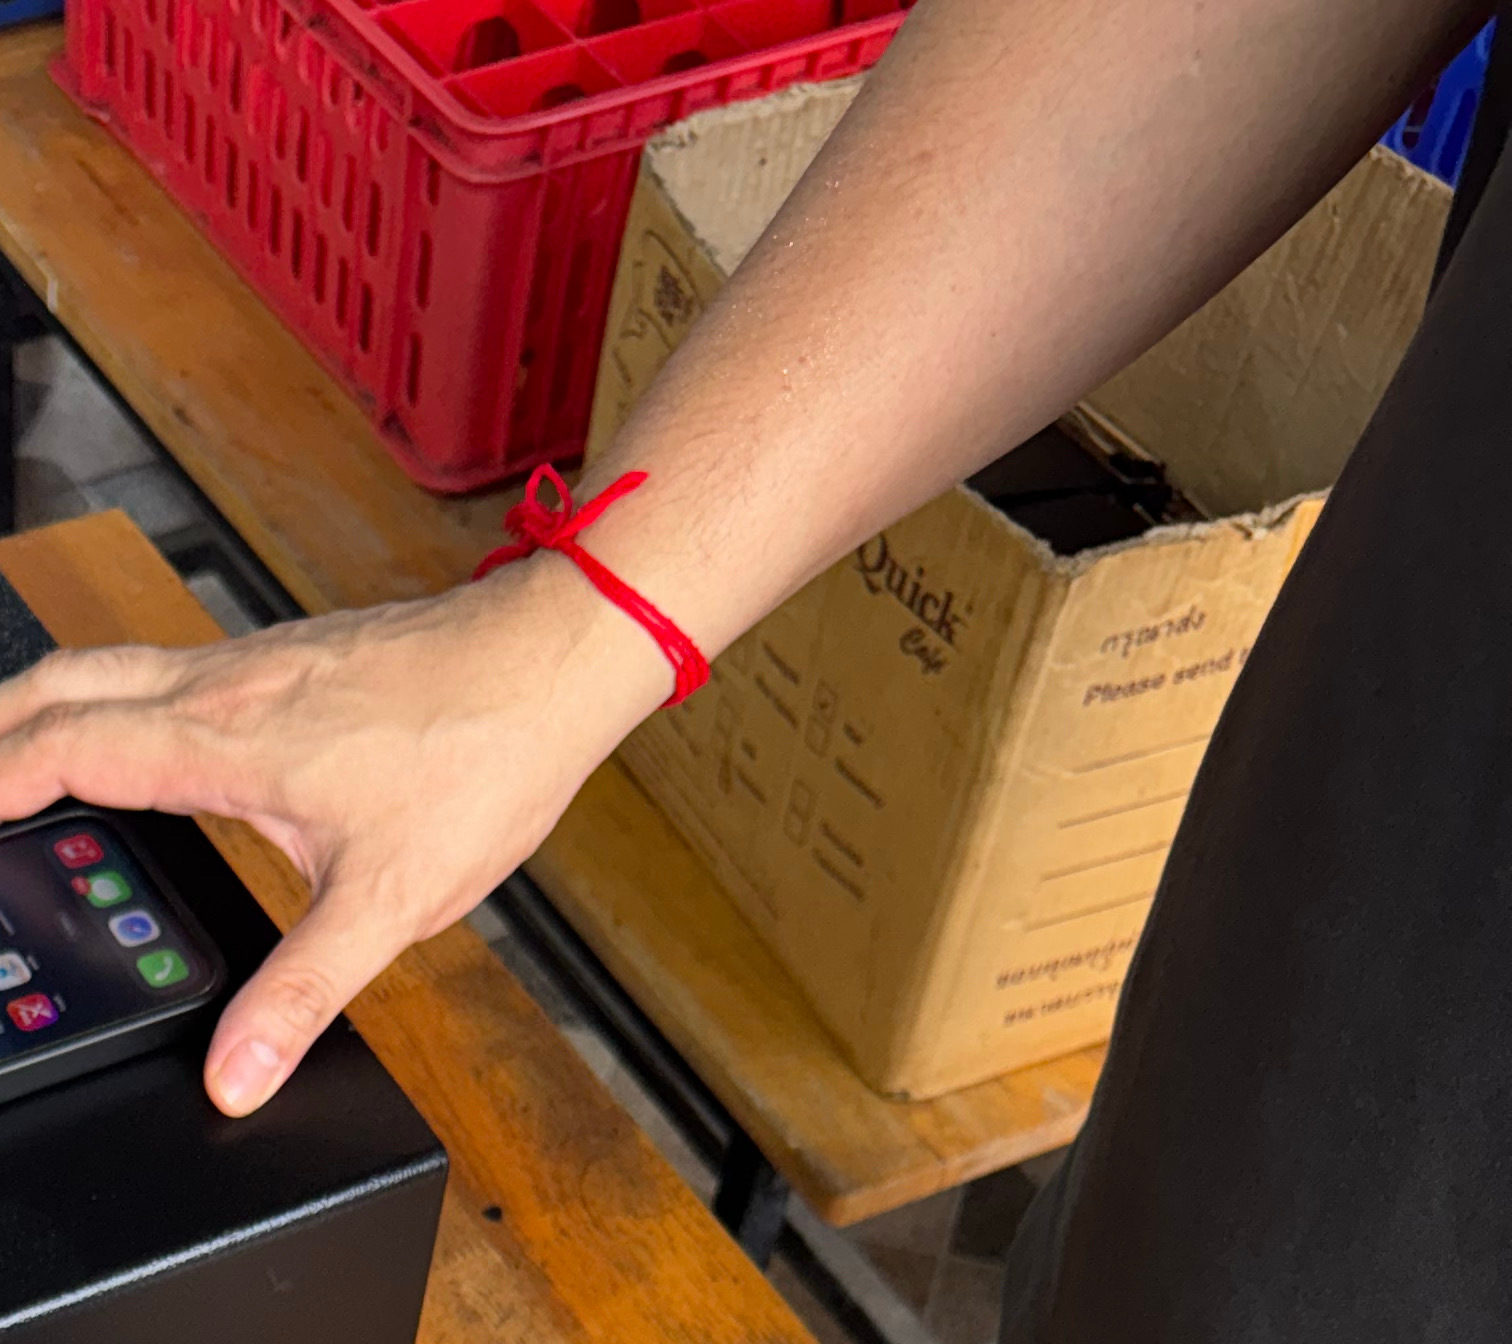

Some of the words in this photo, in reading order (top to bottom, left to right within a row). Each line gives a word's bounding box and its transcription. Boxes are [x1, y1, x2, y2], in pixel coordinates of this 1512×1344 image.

[856, 534, 970, 646] Quick
[1082, 672, 1166, 708] Please
[1170, 658, 1235, 686] send
